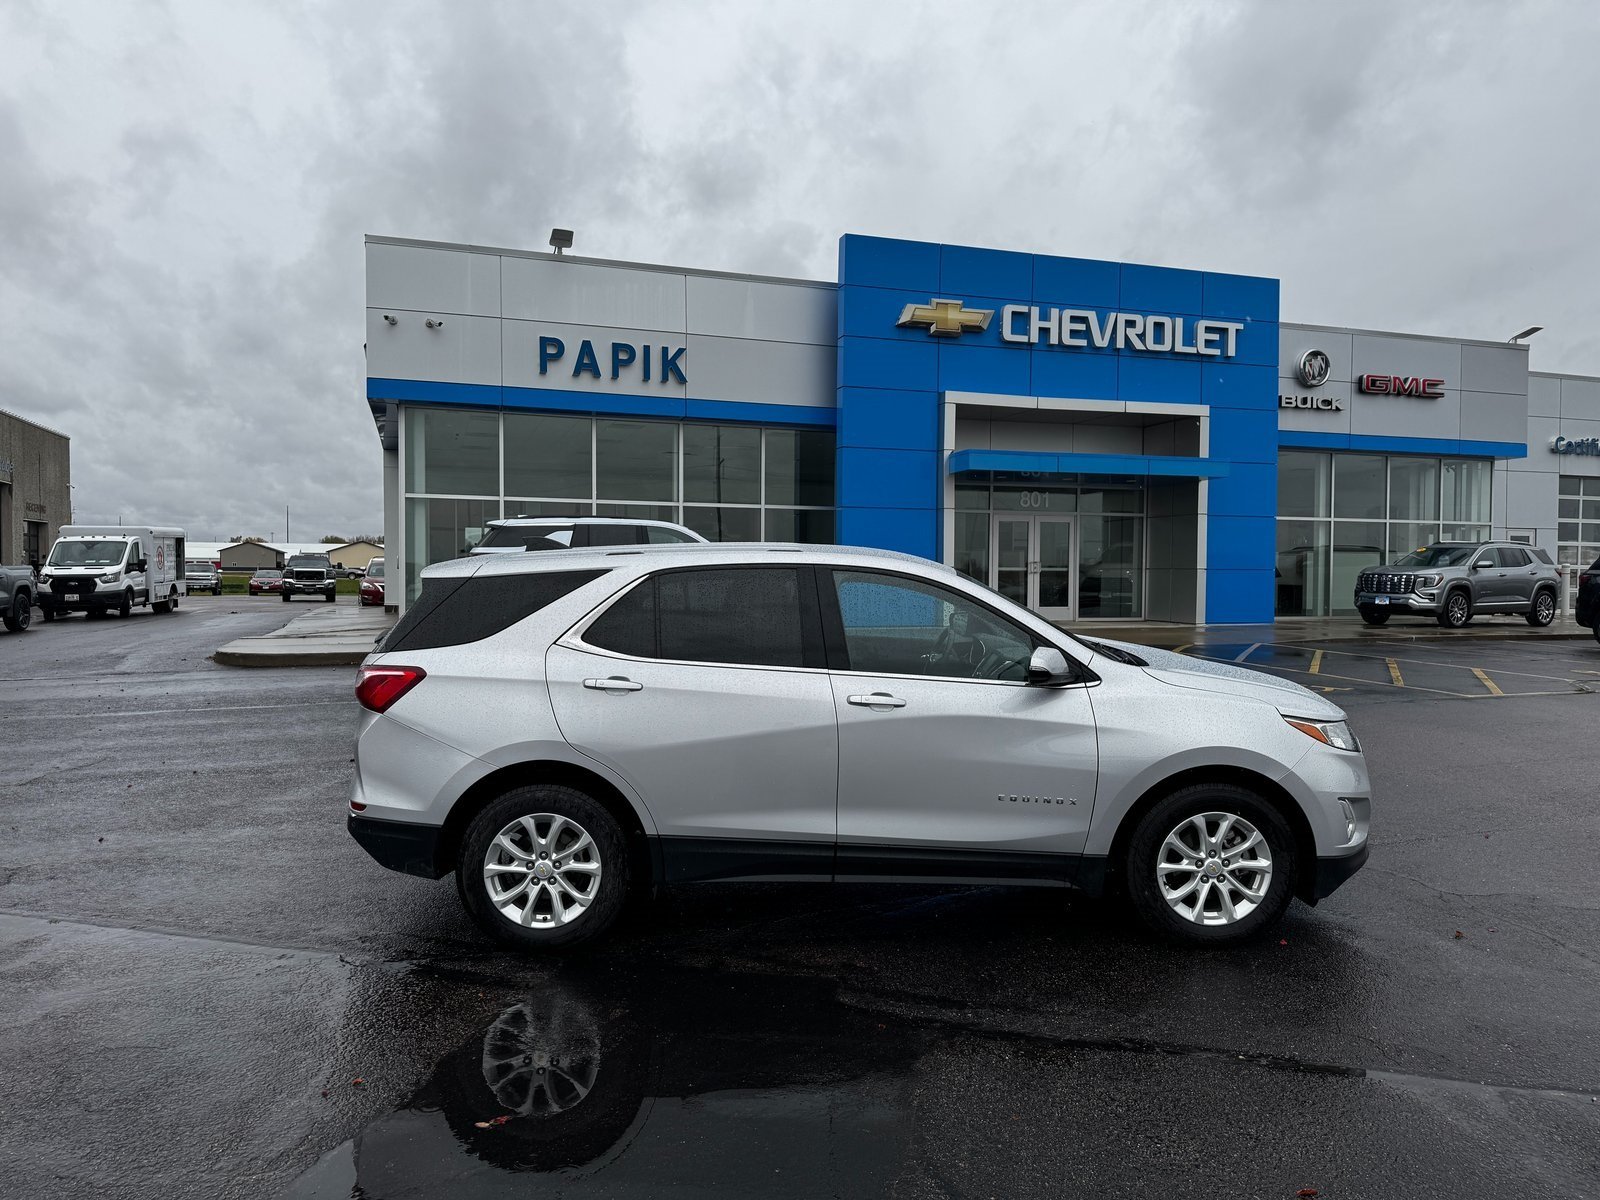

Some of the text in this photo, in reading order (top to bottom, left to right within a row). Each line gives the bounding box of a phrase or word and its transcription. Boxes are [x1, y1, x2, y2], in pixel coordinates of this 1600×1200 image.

[1001, 304, 1244, 357] CHEVROLET
[539, 336, 688, 384] PAPIK
[1360, 374, 1445, 398] GMC
[1280, 395, 1343, 411] BUICK
[1020, 491, 1049, 508] 801
[997, 794, 1078, 806] EQUINOX
